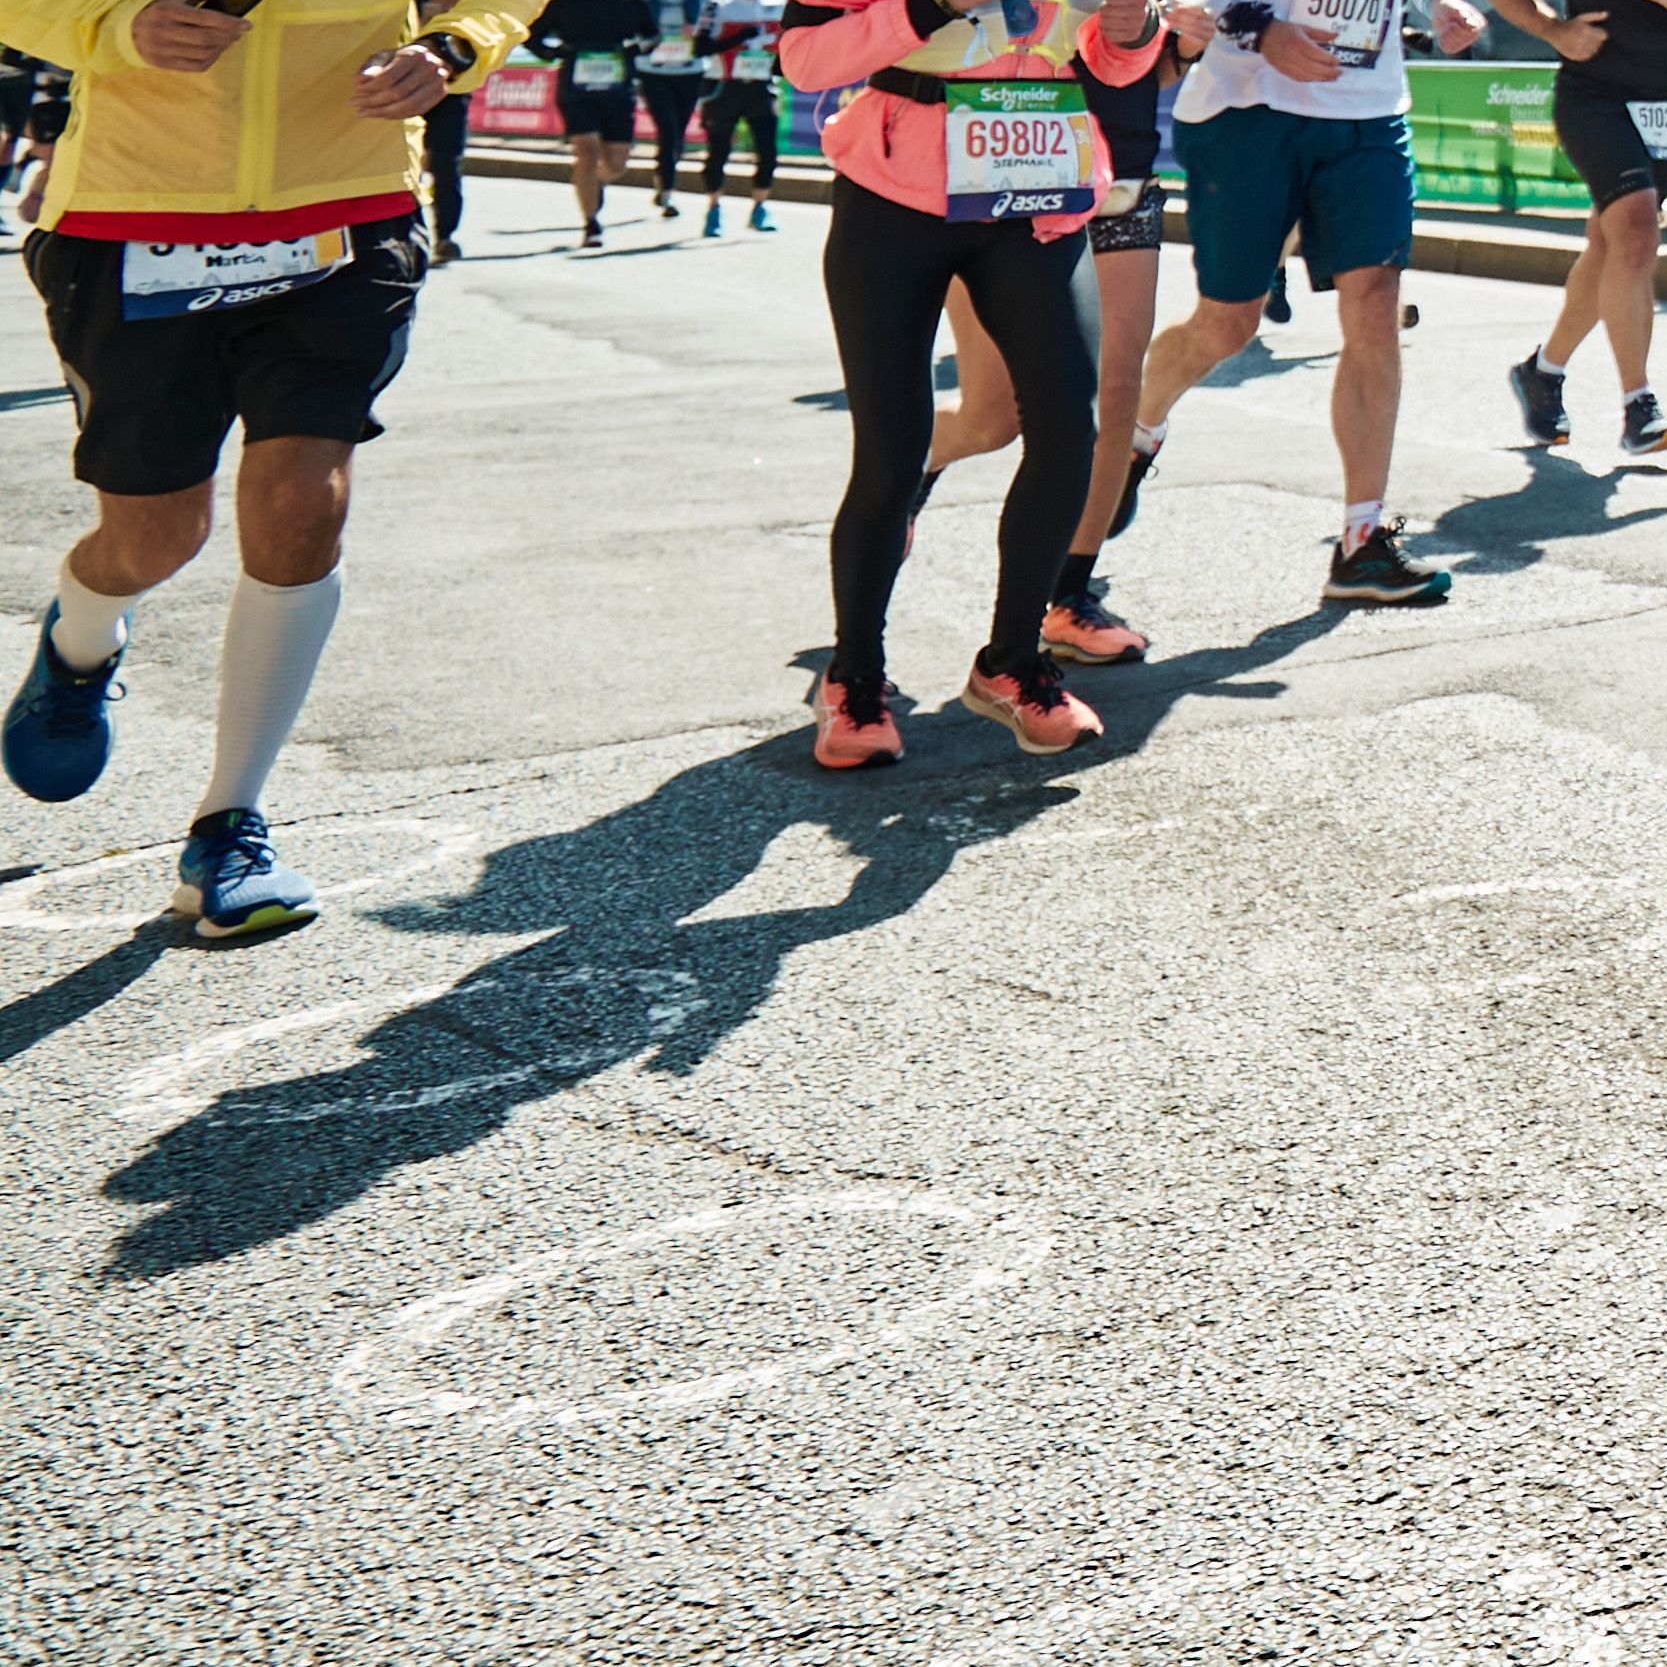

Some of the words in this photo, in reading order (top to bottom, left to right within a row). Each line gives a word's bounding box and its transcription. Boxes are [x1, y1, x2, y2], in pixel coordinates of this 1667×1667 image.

[980, 87, 1059, 103] Schneider
[966, 120, 1068, 158] 69802
[1011, 194, 1064, 211] asics
[223, 280, 293, 304] asics
